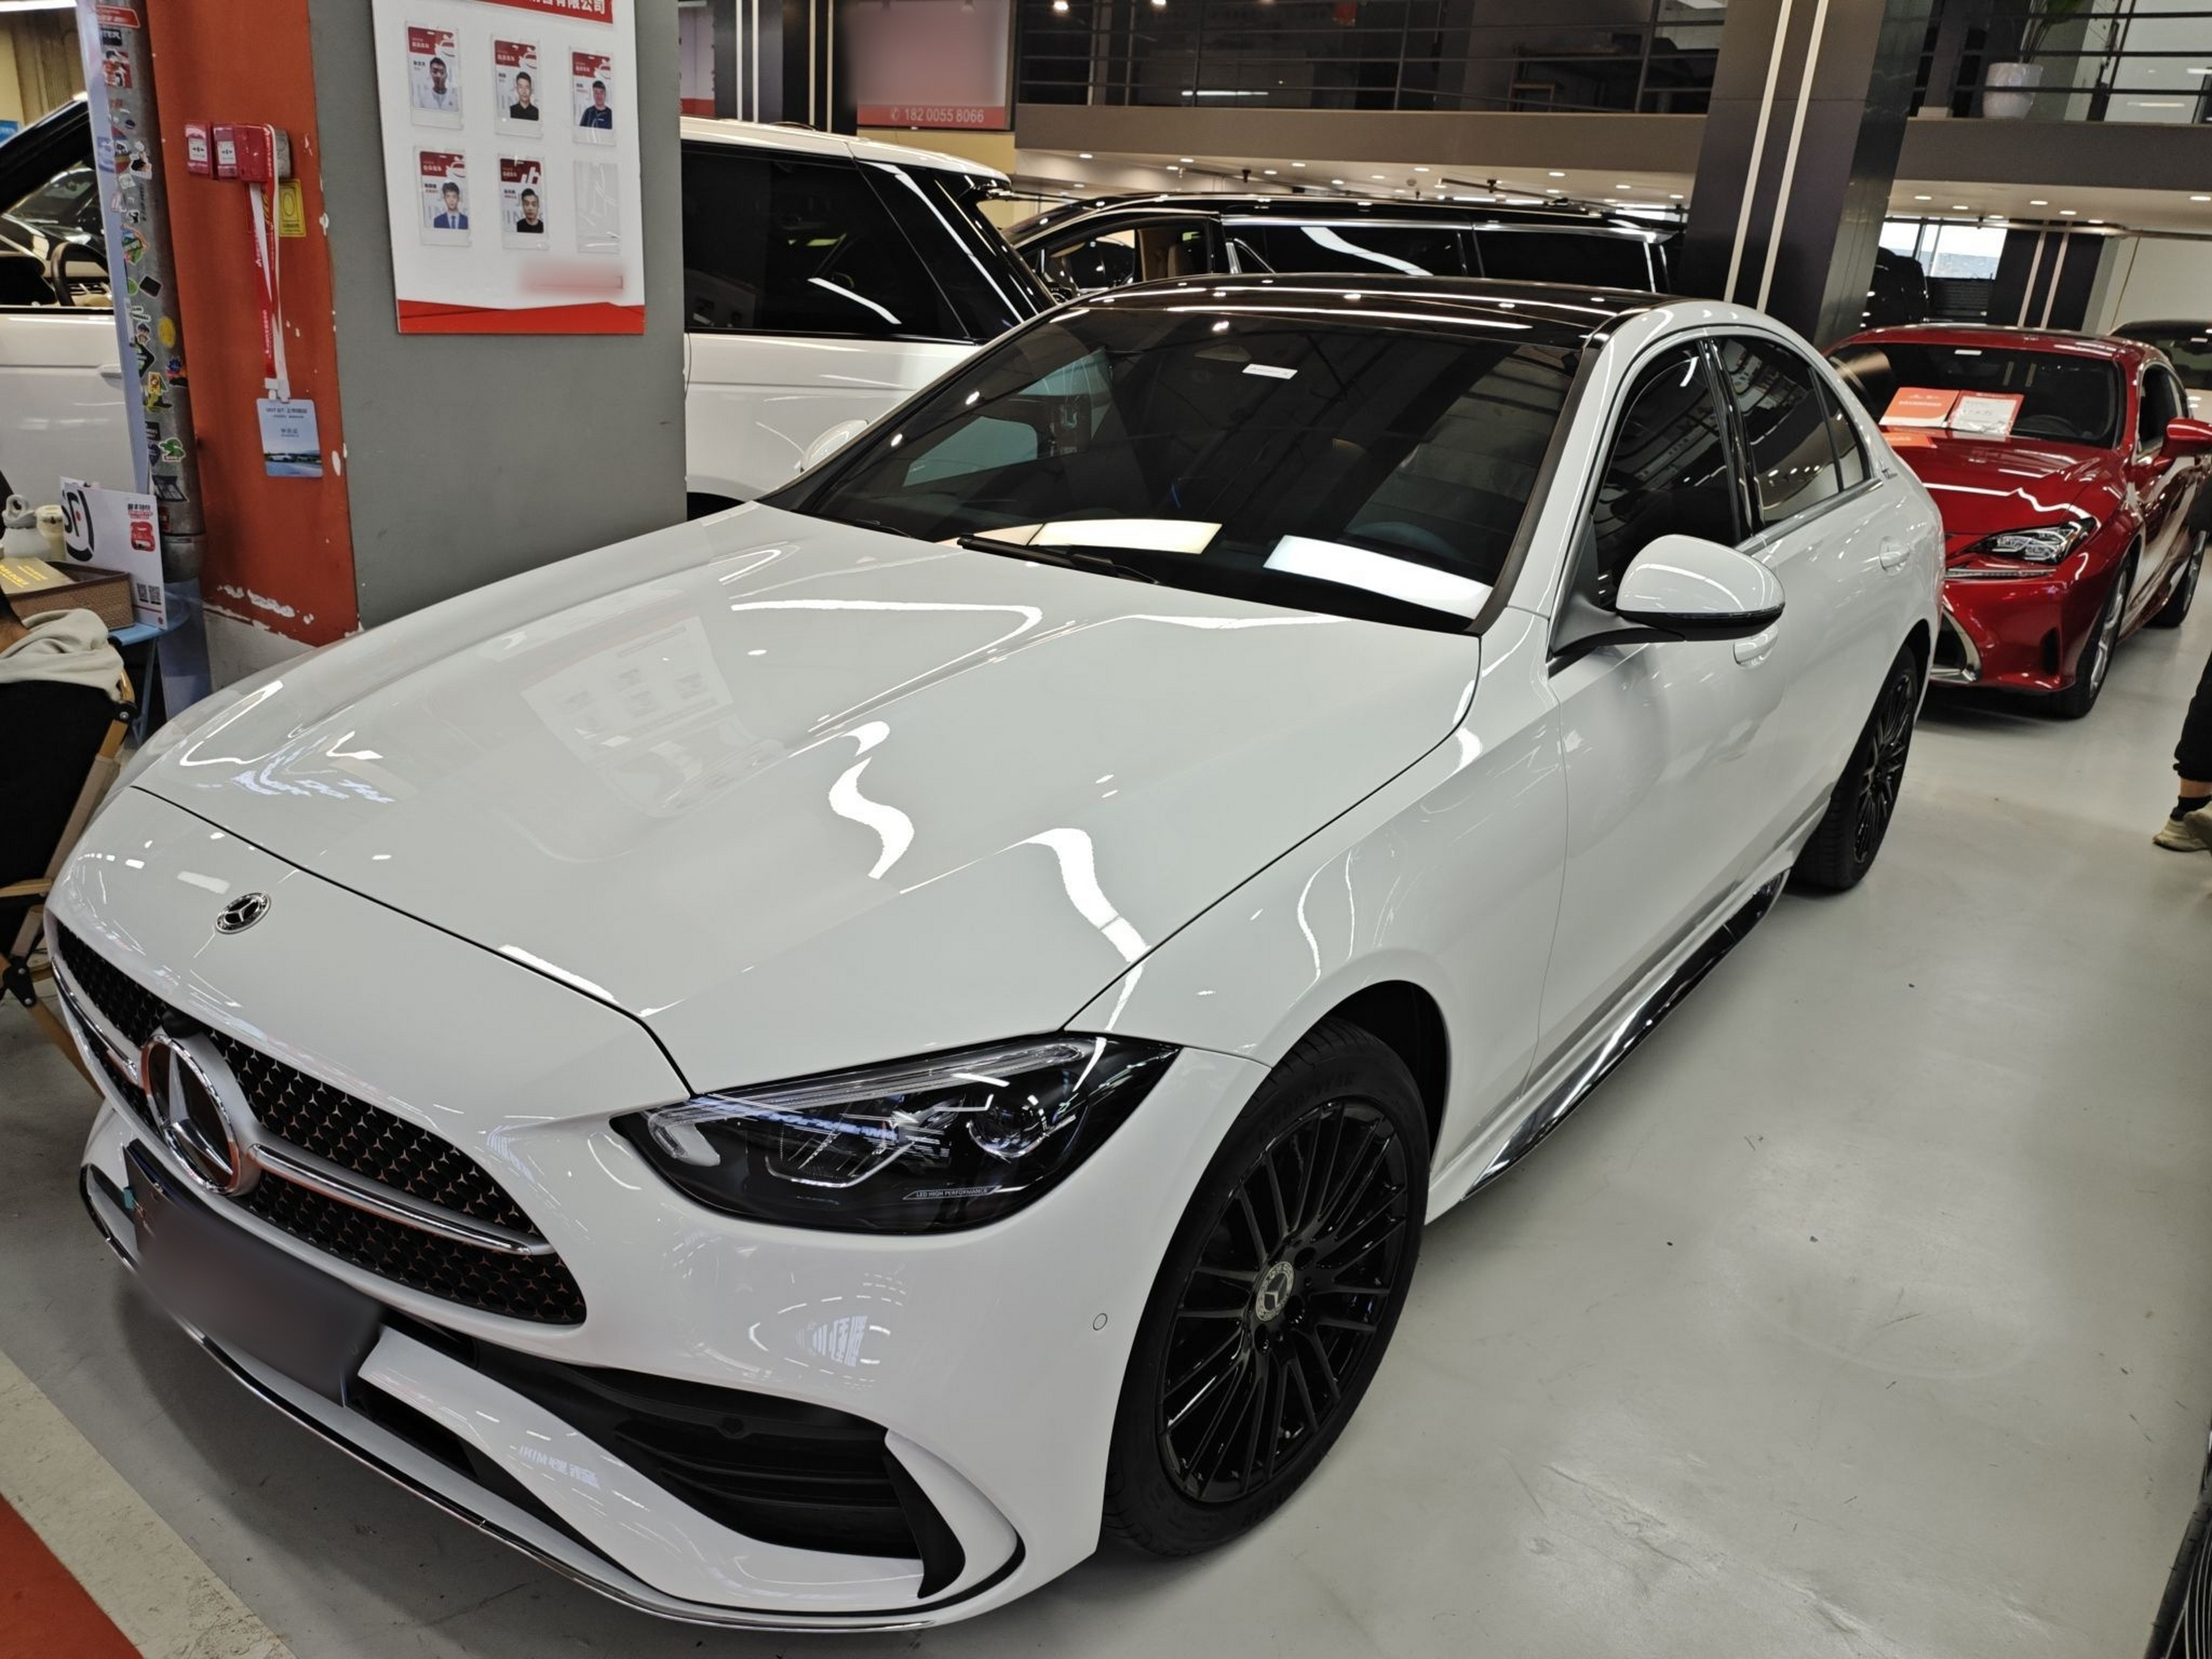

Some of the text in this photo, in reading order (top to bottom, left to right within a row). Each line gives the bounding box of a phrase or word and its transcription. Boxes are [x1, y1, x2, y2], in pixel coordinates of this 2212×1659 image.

[905, 107, 984, 123] 182 0055 8066
